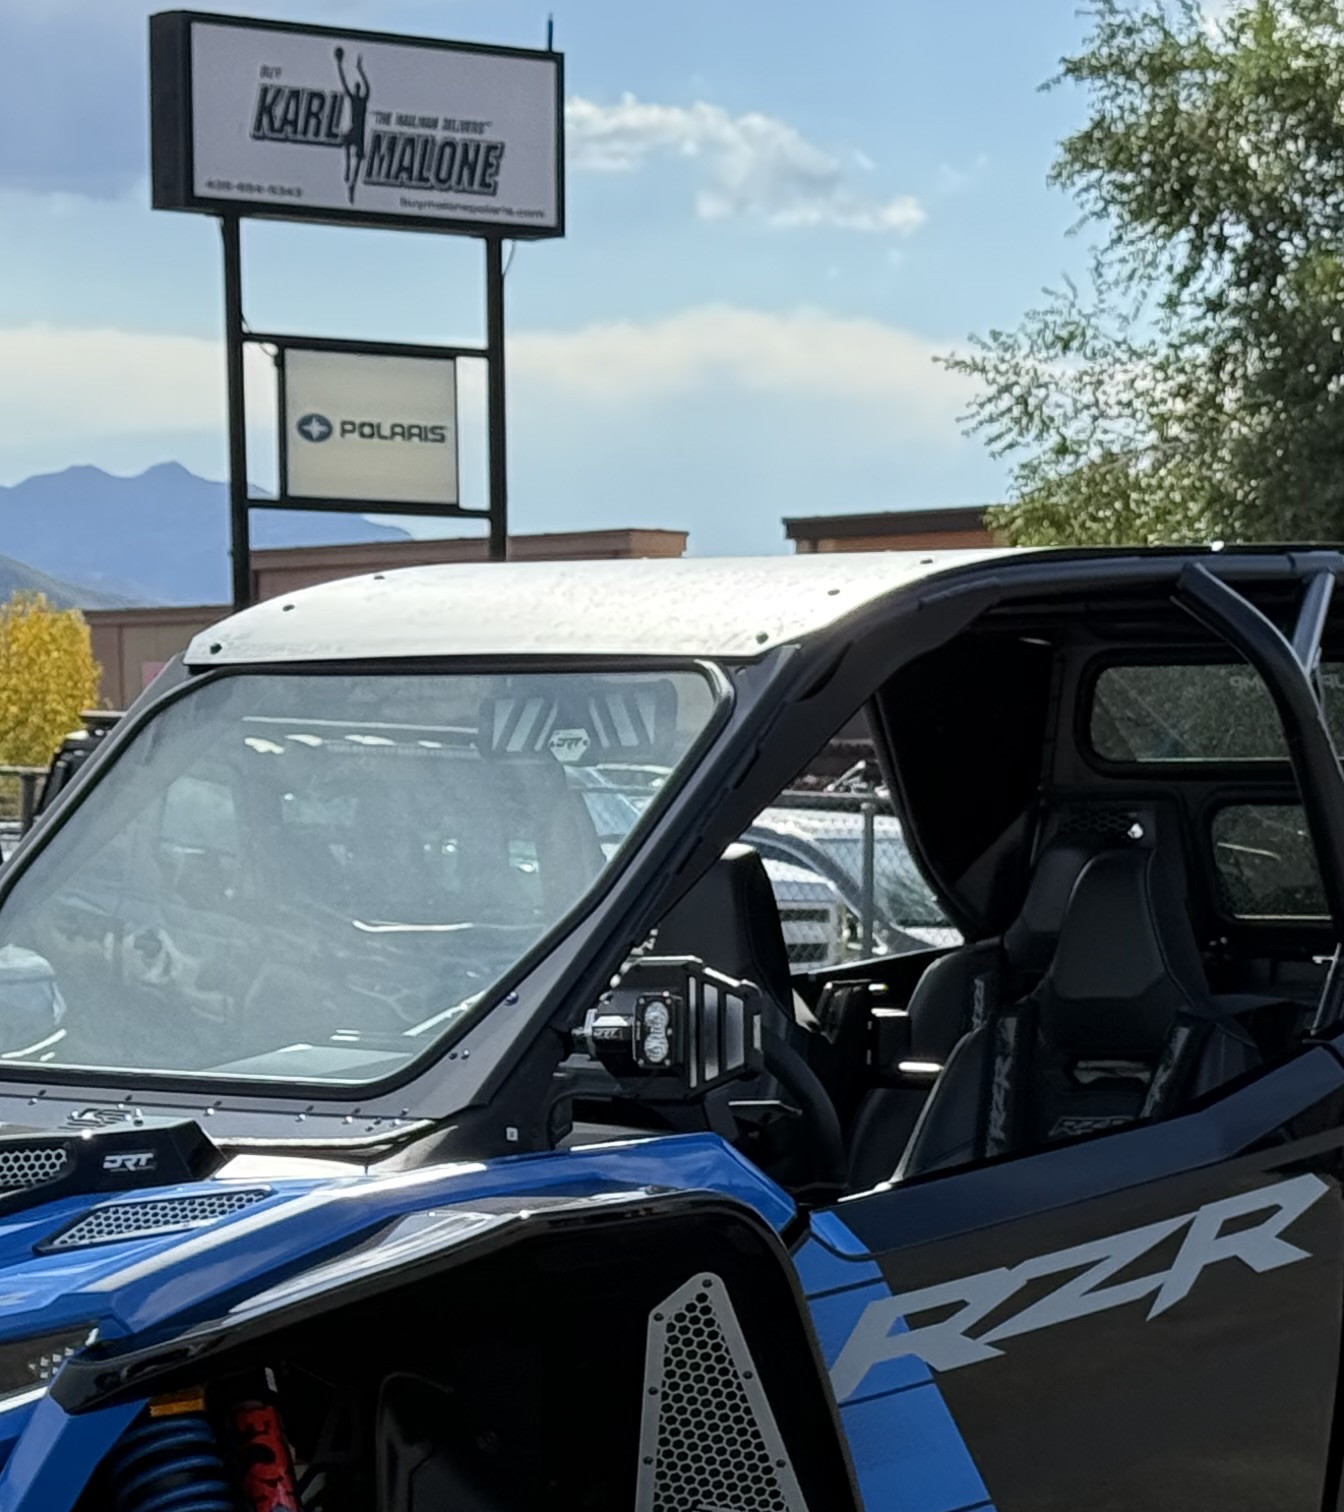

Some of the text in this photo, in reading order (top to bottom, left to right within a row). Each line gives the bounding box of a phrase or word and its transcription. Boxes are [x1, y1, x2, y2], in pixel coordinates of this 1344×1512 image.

[252, 84, 344, 147] KARL
[363, 131, 505, 196] MALONE
[339, 420, 448, 443] POLARIS
[103, 1153, 154, 1171] DRT
[828, 1172, 1331, 1404] RZR
